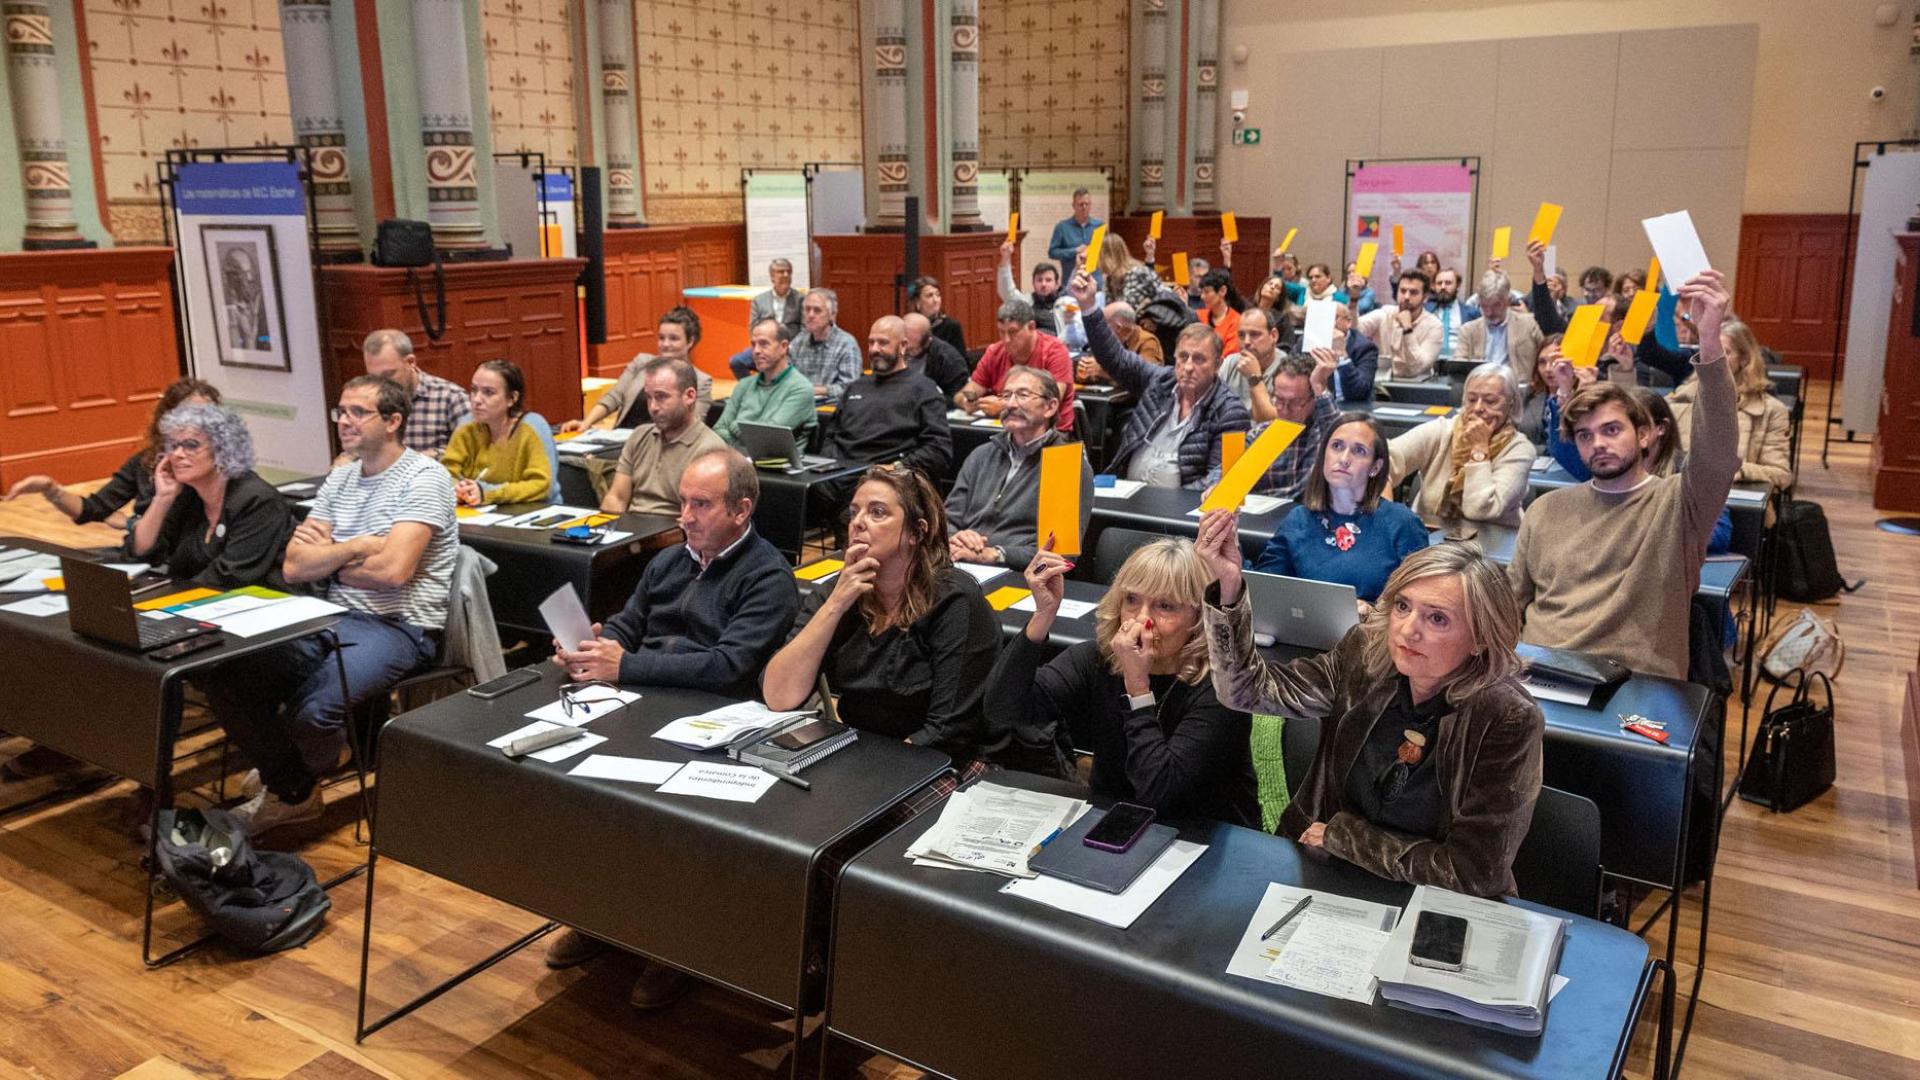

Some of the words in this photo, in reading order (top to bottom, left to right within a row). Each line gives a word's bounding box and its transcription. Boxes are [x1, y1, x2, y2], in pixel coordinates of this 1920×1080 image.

[270, 186, 296, 199] Escher
[698, 768, 737, 779] Comarca
[688, 775, 757, 788] Independientes
